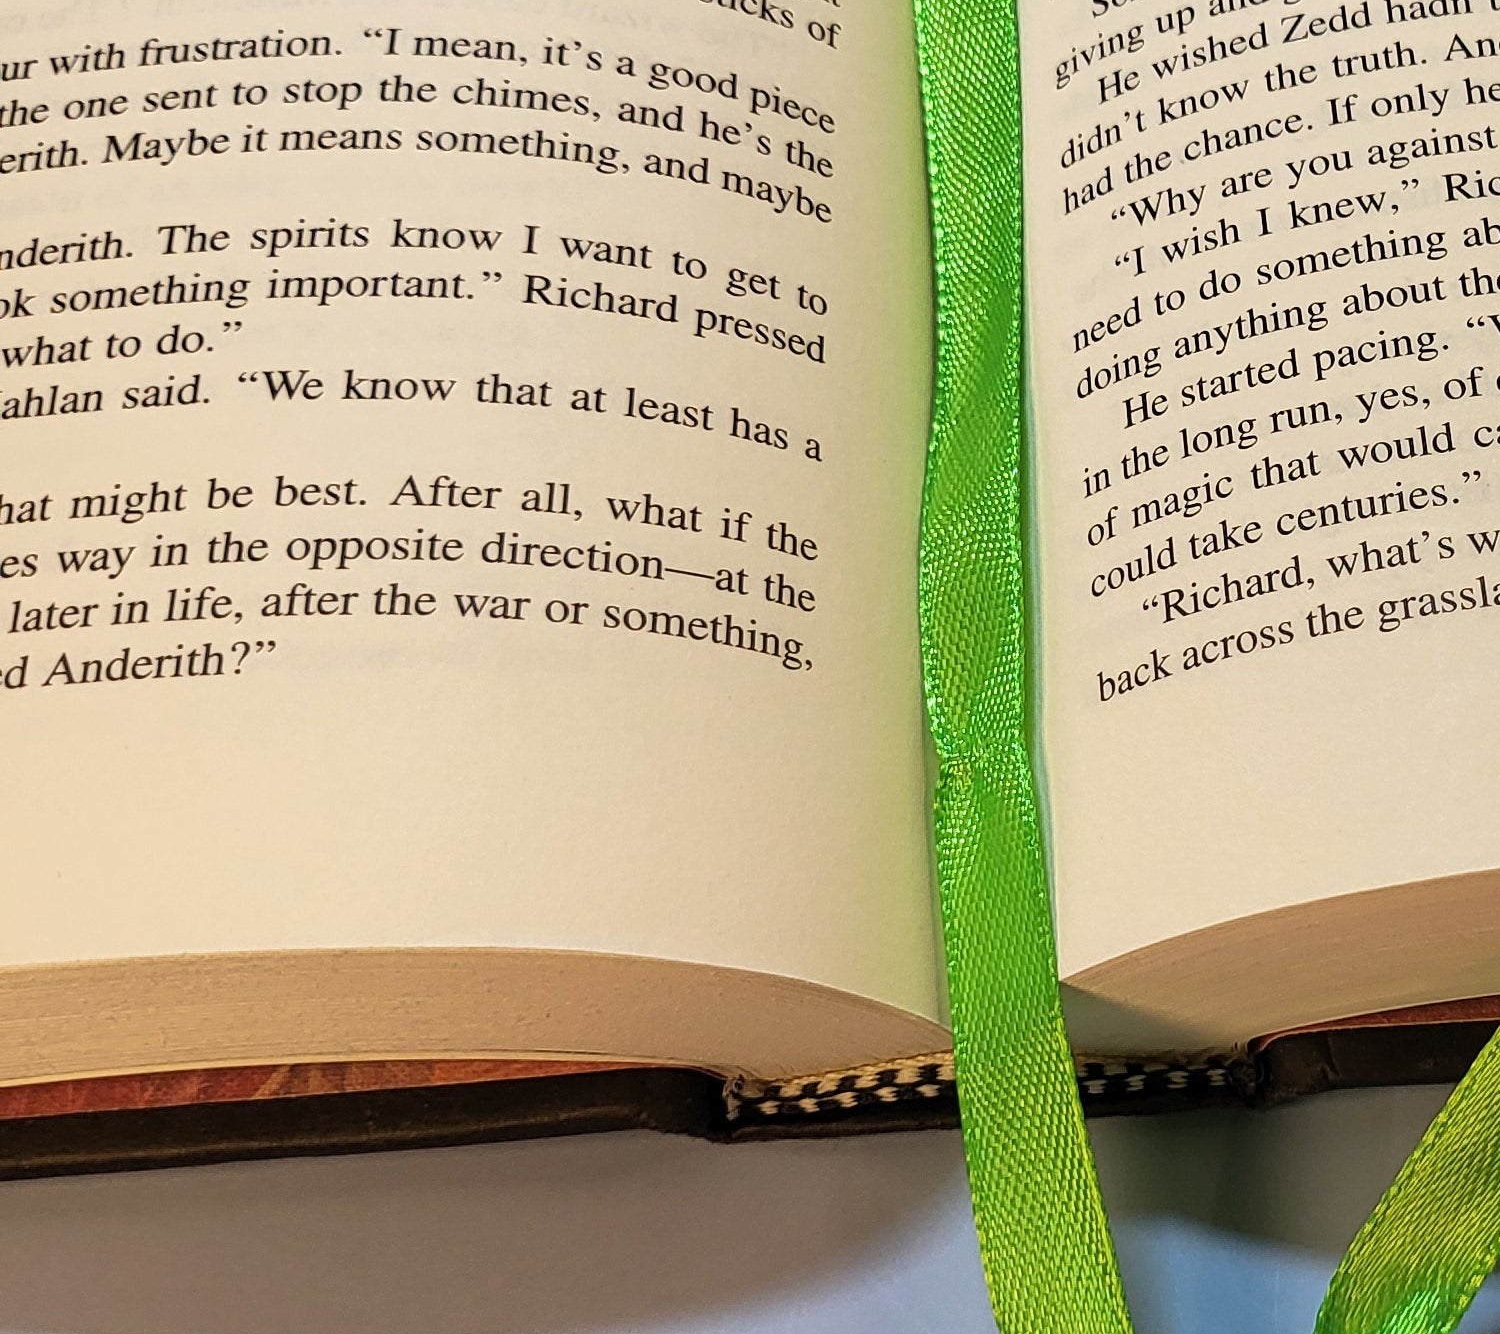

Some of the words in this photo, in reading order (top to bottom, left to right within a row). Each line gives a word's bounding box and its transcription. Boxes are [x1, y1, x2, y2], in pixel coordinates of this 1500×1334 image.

[1112, 185, 1206, 226] “Why
[1222, 169, 1273, 197] are
[1285, 151, 1353, 189] you
[1368, 126, 1498, 169] against
[158, 224, 230, 255] The
[250, 218, 369, 257] spirits
[390, 219, 502, 251] know
[522, 225, 540, 254] I
[560, 237, 652, 269] want
[672, 252, 707, 279] to
[726, 268, 780, 299] get
[797, 285, 827, 315] to
[1077, 347, 1161, 398] doing
[1175, 302, 1328, 358] anything
[1343, 276, 1447, 316] about
[69, 482, 188, 524] might
[208, 478, 253, 509] be
[275, 476, 366, 506] best.
[389, 475, 502, 509] After
[521, 483, 582, 521] all,
[606, 494, 702, 532] what
[720, 508, 752, 542] if
[766, 522, 818, 560] the
[1143, 555, 1314, 623] “Richard,
[1326, 531, 1454, 578] what’s
[8, 600, 99, 633] later
[111, 592, 149, 625] in
[163, 586, 242, 624] life,
[261, 583, 359, 617] after
[374, 583, 436, 615] the
[454, 595, 531, 620] war
[545, 600, 589, 625] or
[604, 606, 812, 671] something,
[41, 640, 276, 686] Anderith?”
[1097, 649, 1173, 701] back
[1183, 621, 1294, 670] across
[1306, 603, 1364, 637] the
